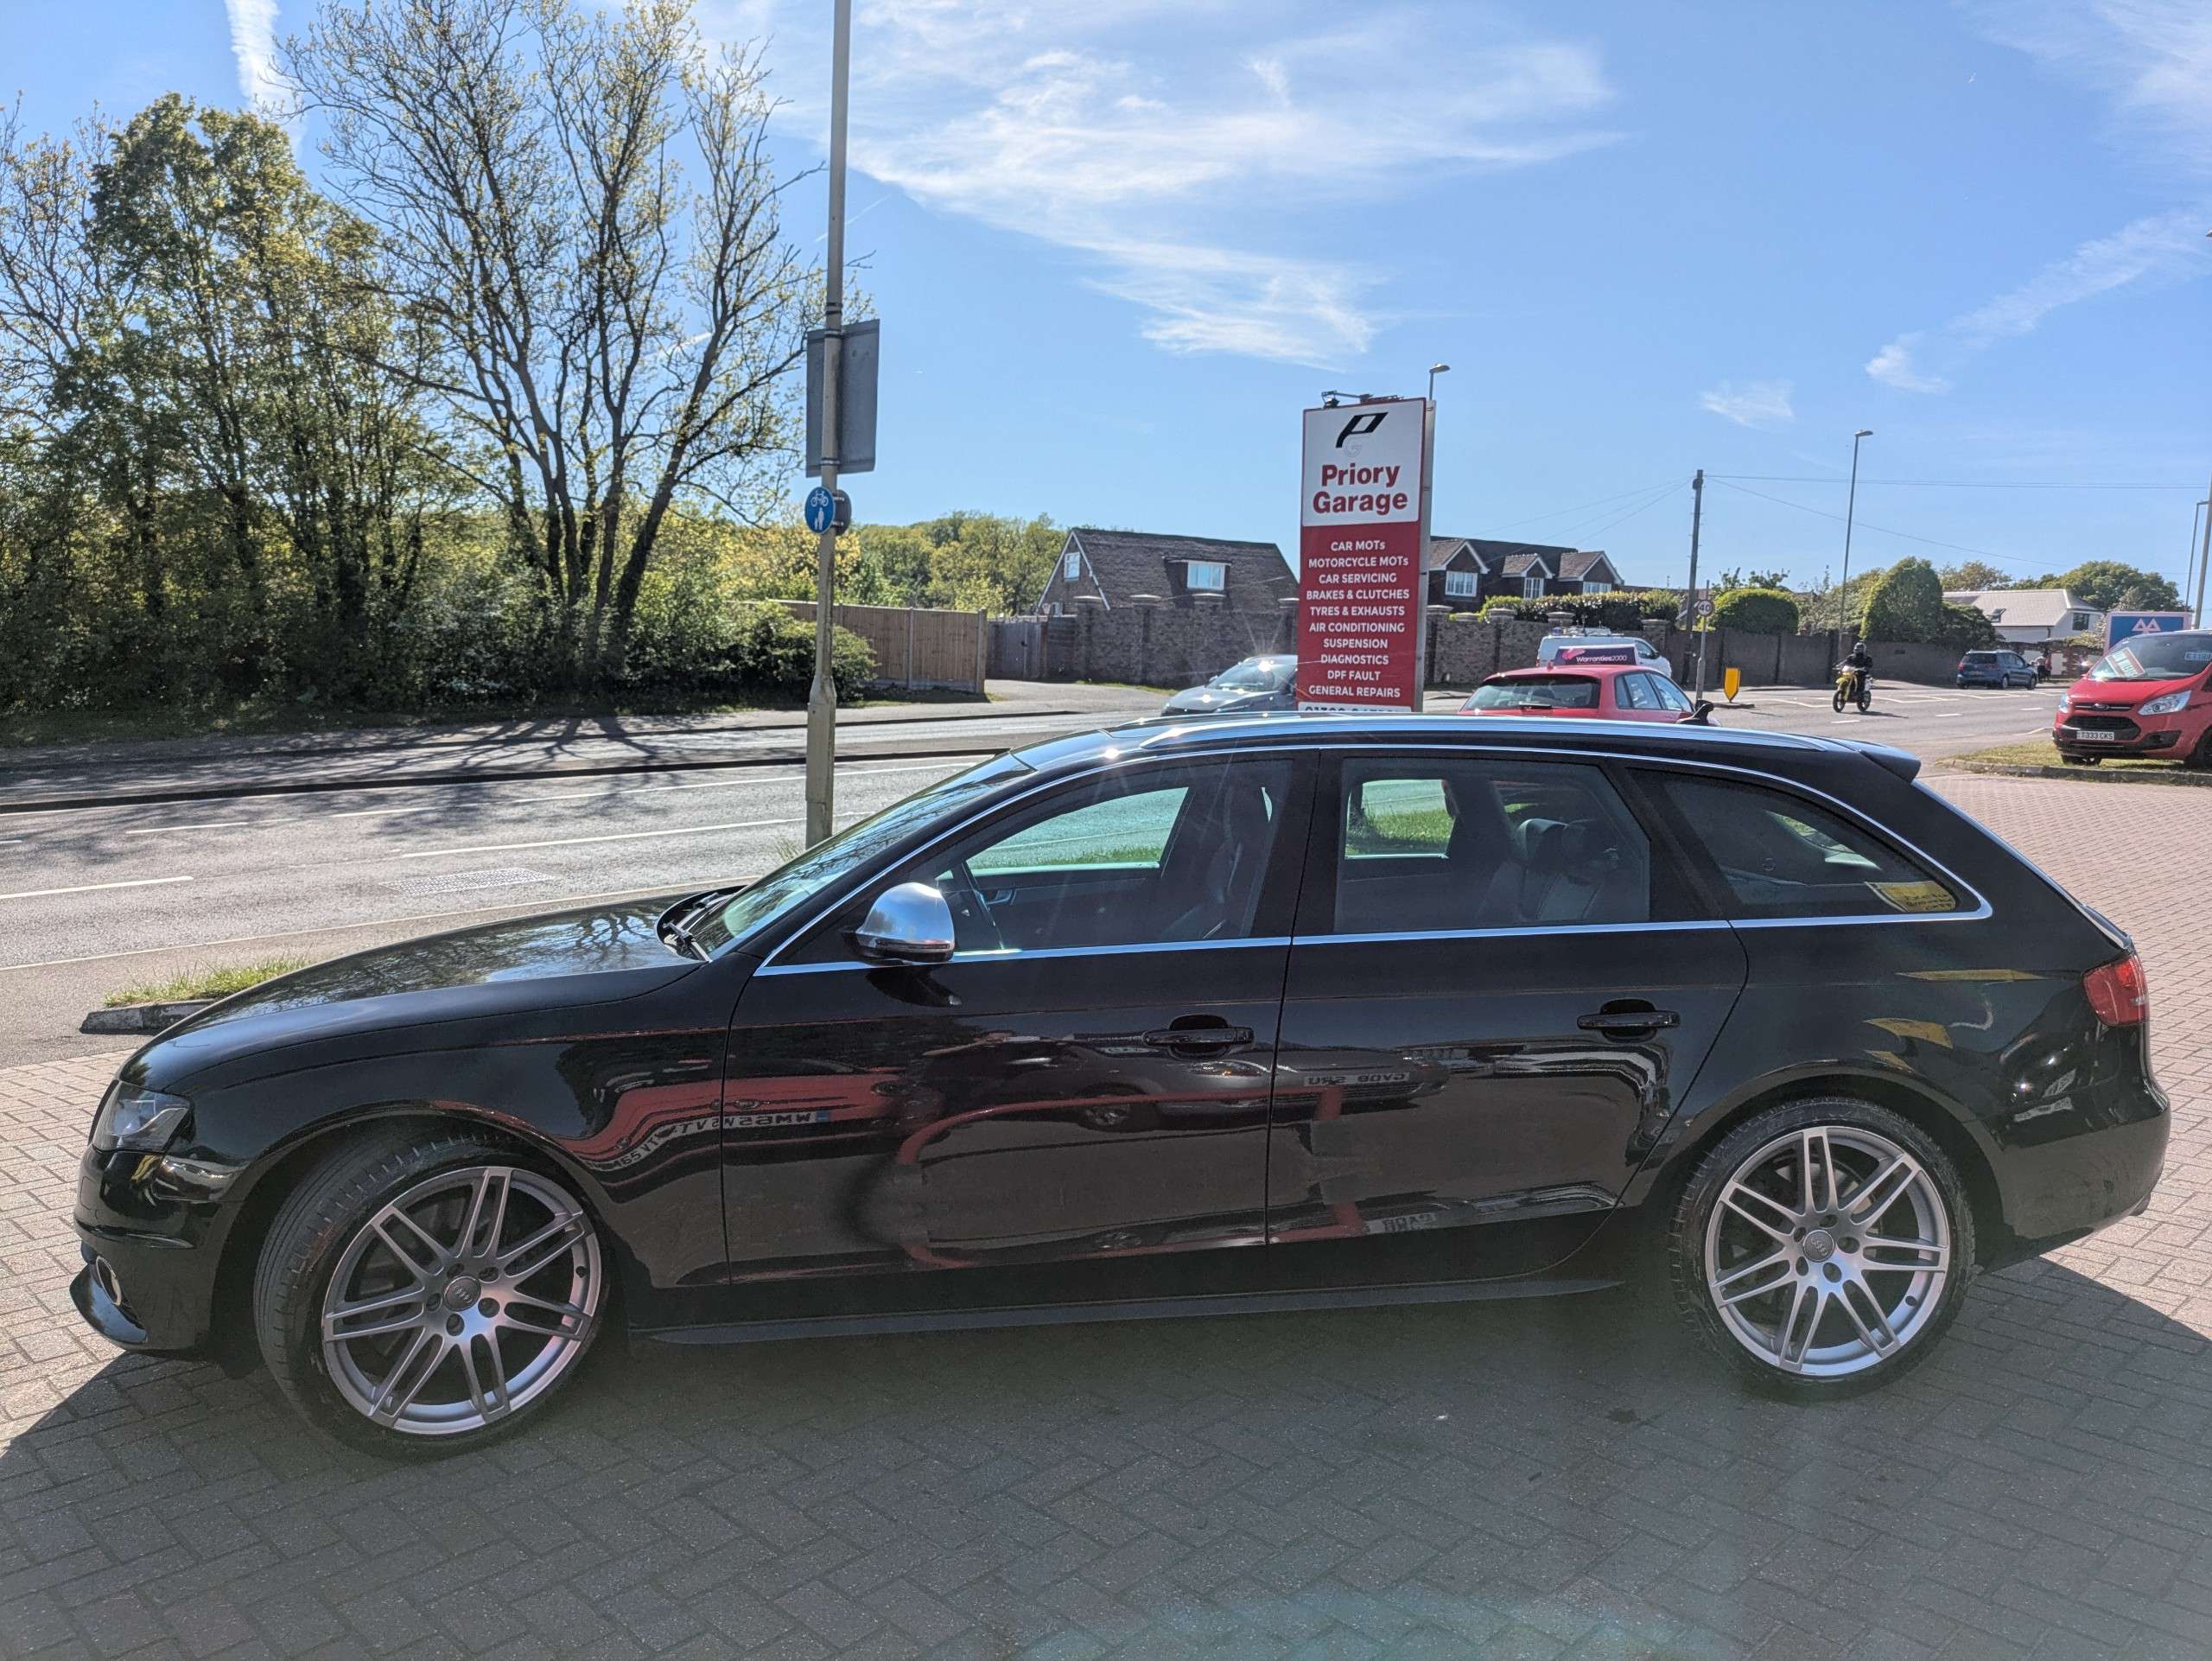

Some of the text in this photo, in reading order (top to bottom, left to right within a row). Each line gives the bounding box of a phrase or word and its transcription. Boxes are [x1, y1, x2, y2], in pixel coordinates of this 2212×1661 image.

[1321, 462, 1401, 488] Priory
[1313, 491, 1408, 516] Garage
[1331, 539, 1386, 551] CAR MOTs
[1308, 556, 1409, 568] MOTORCYCLE MOTs
[1319, 572, 1397, 584] CAR SERVICING
[1306, 589, 1410, 601] BRAKES & CLUTCHES
[1309, 605, 1405, 616] TYRES & EXHAUSTS
[1308, 621, 1405, 633] AIR CONDITIONING
[1323, 638, 1389, 649] SUSPENSION
[1320, 653, 1389, 665] DIAGNOSTICS
[1327, 670, 1382, 680] DPF FAULT
[1308, 684, 1401, 698] GENERAL REPAIRS
